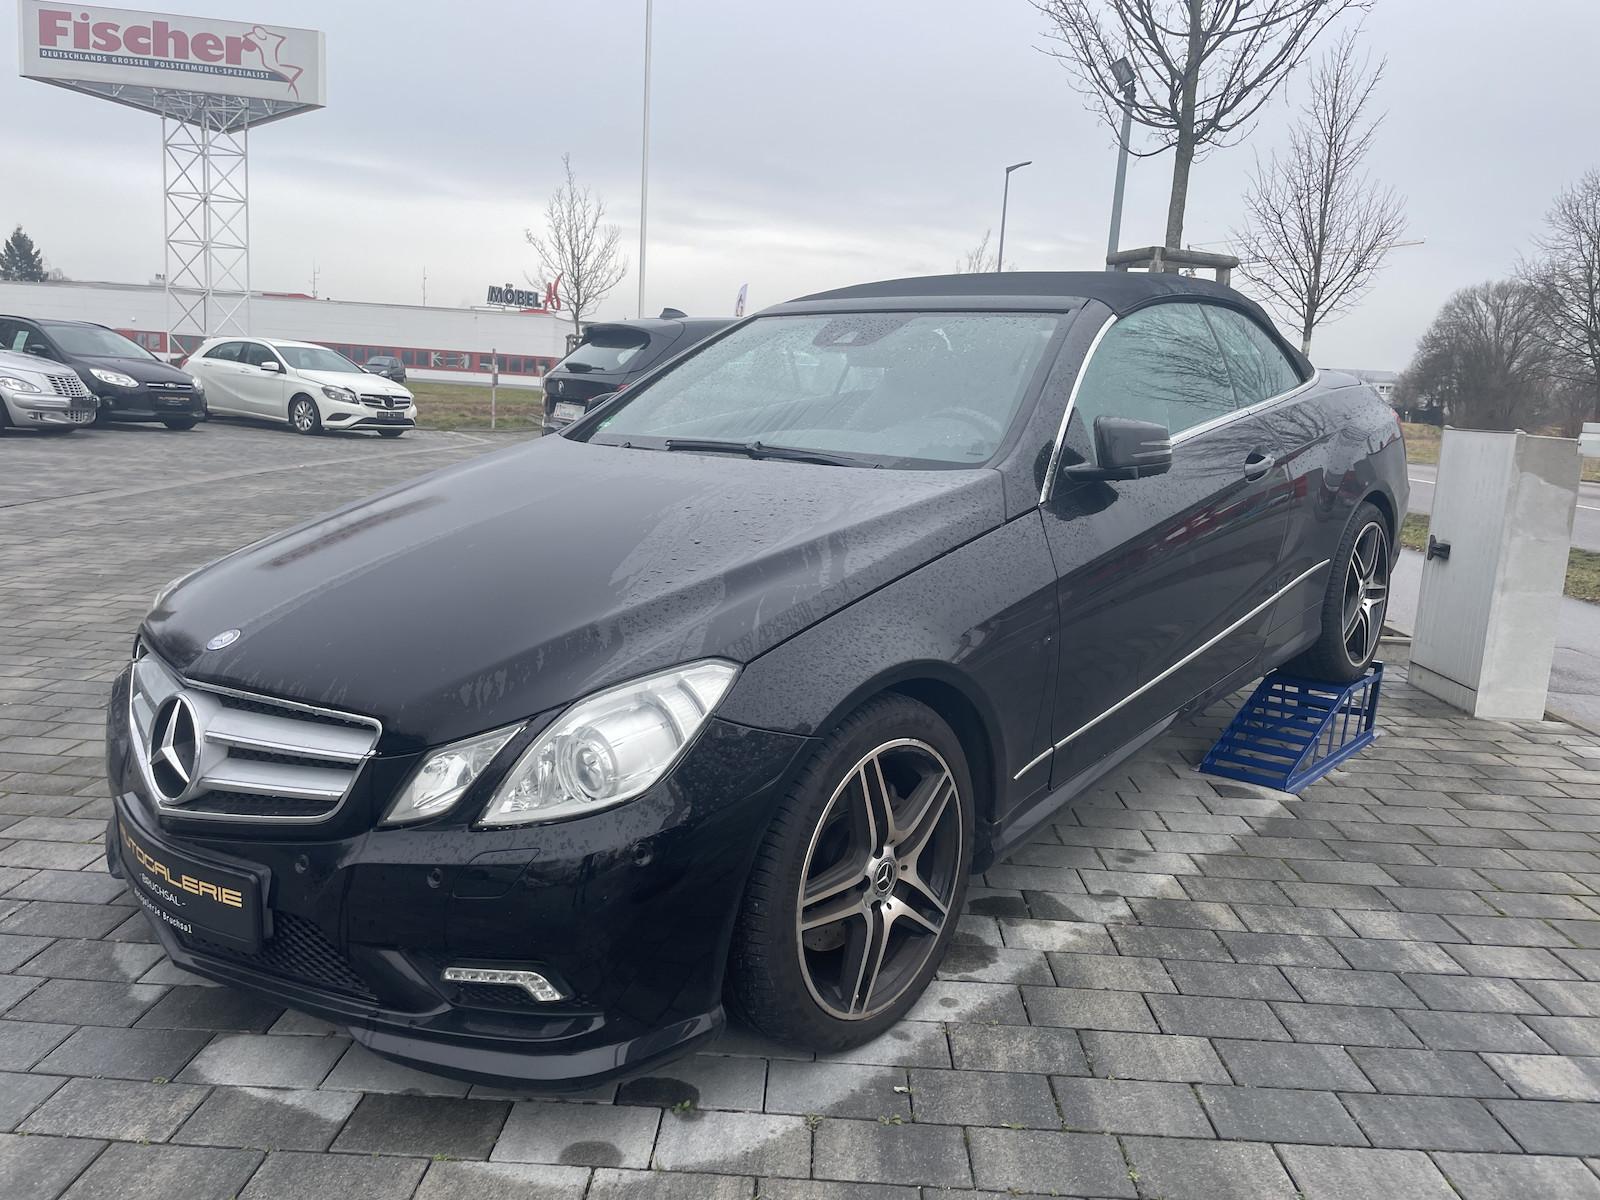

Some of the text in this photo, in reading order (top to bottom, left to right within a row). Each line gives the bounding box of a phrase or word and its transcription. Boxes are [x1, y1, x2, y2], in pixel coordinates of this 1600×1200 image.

[38, 9, 257, 65] Fischer
[42, 50, 107, 62] DEUTSCHLANDS
[488, 284, 541, 307] MÖBEL
